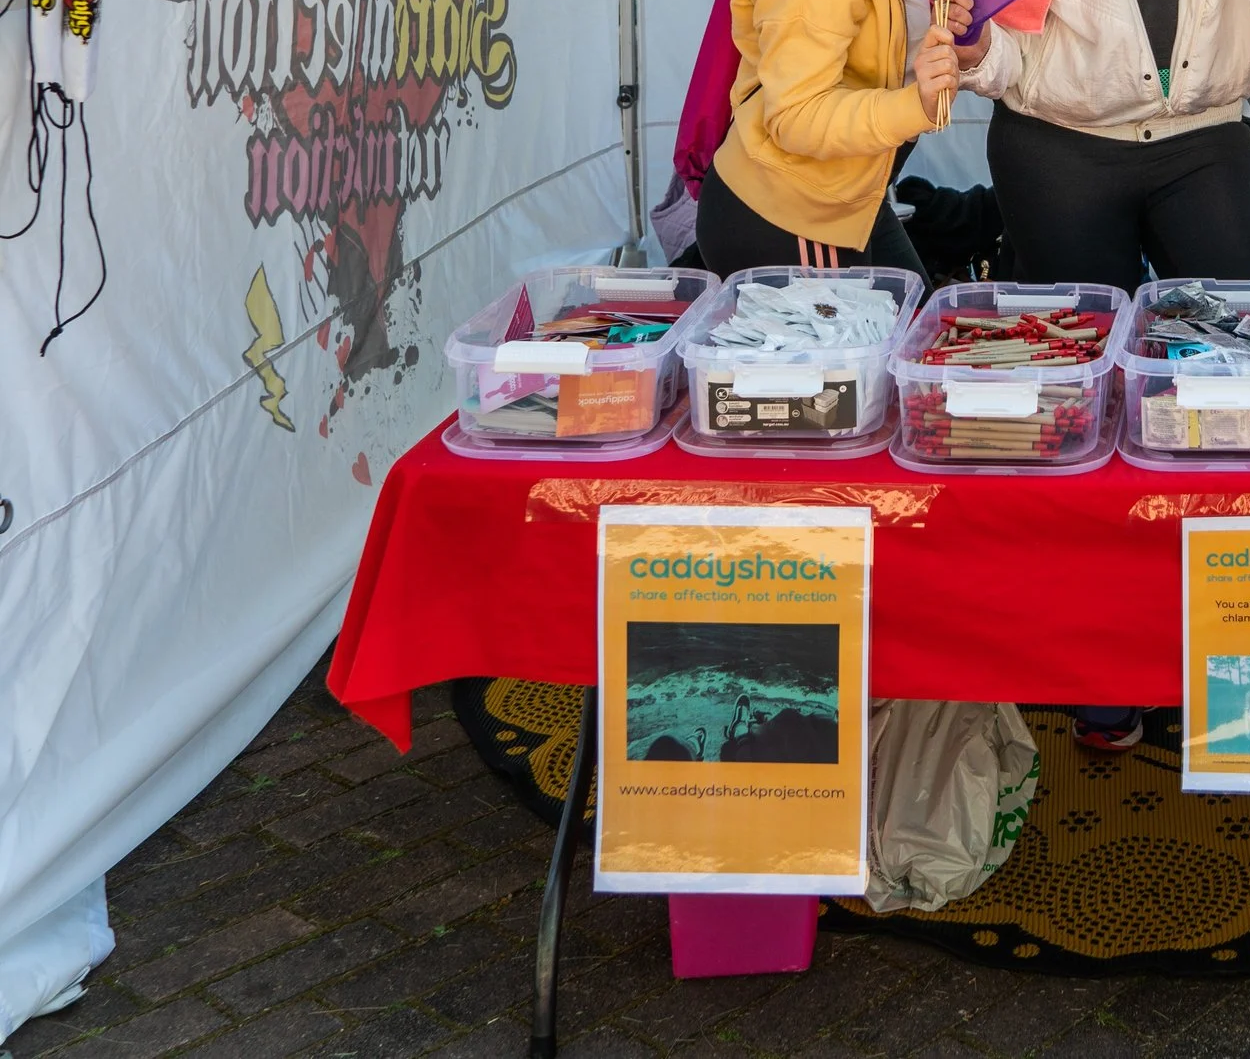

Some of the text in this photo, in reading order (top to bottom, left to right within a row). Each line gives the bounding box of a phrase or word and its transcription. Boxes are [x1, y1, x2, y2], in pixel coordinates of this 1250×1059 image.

[630, 551, 837, 587] caddyshack
[1206, 574, 1232, 583] share
[630, 588, 837, 604] share affection, not infection
[1215, 600, 1235, 609] You
[619, 784, 845, 800] www.caddydshackproject.com
